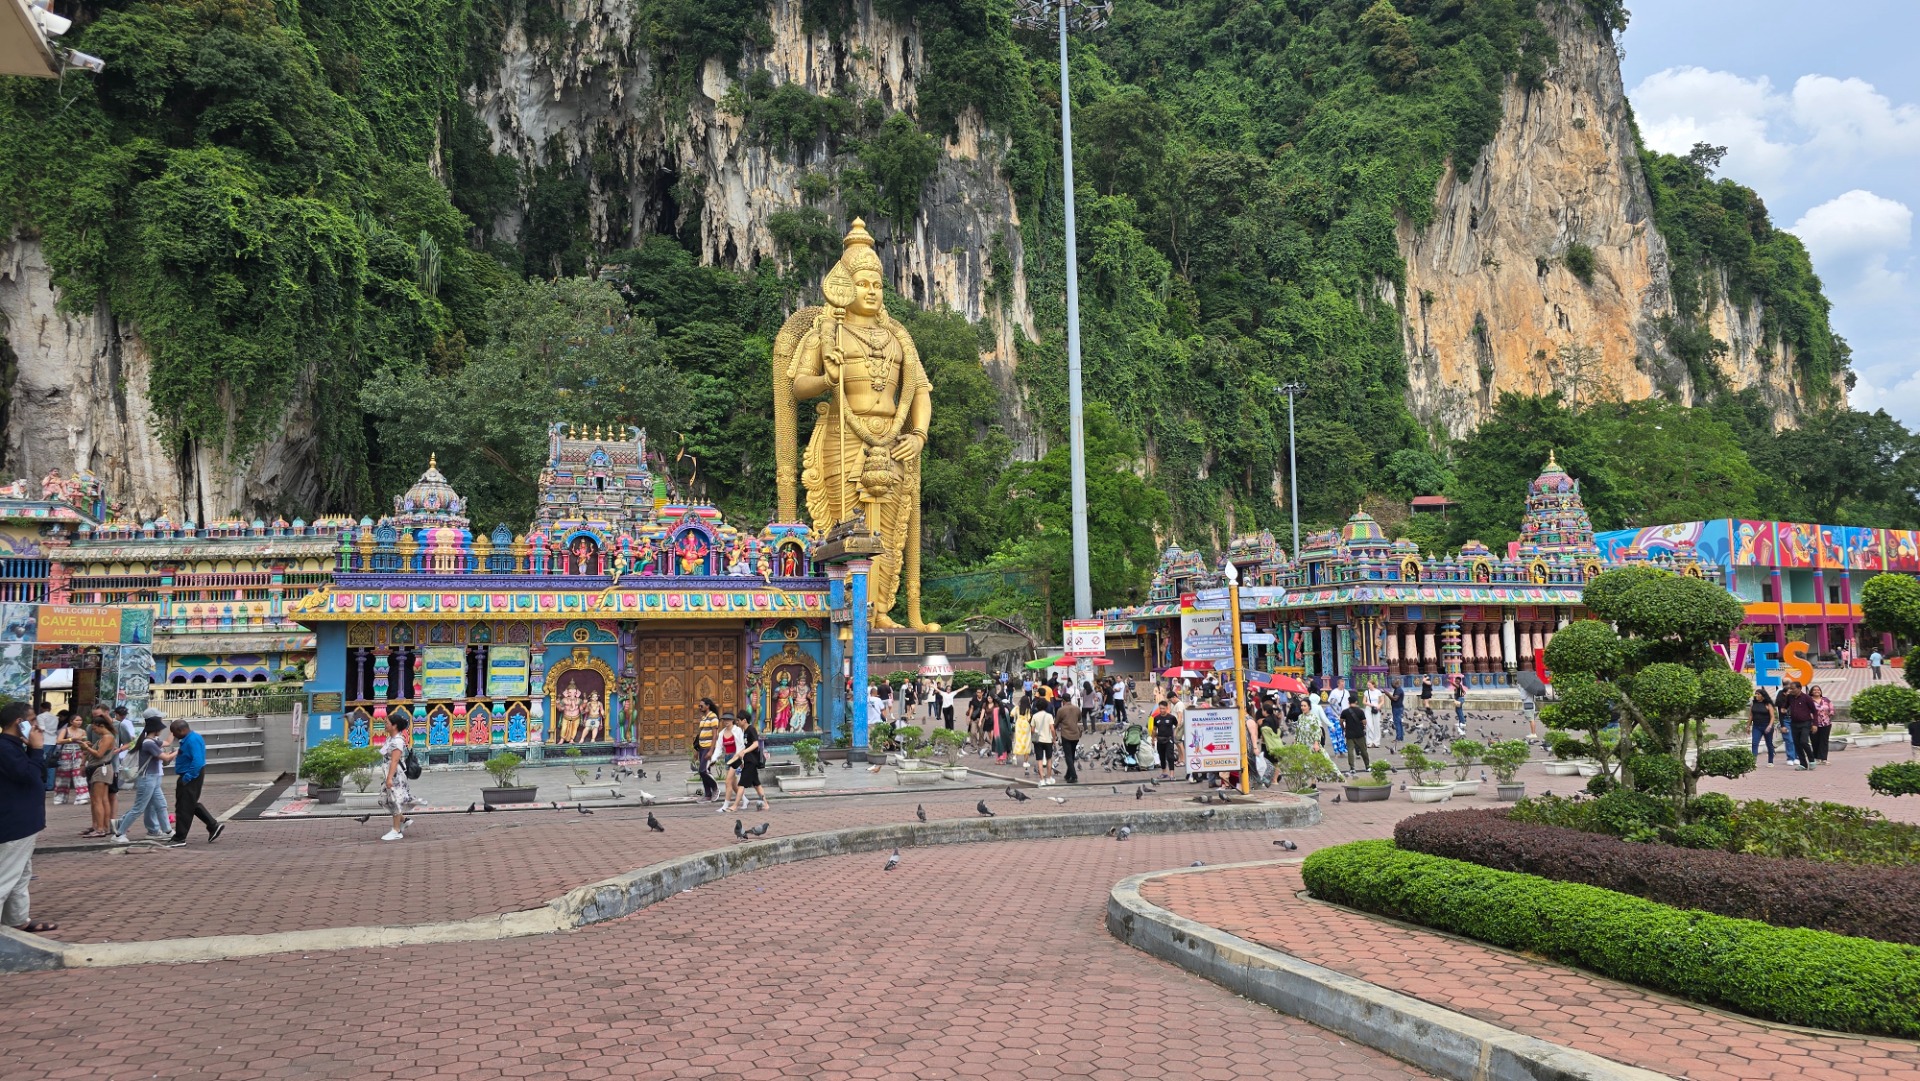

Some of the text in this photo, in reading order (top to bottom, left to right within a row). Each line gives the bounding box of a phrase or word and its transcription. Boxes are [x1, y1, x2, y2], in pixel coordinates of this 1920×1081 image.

[53, 607, 94, 615] WELCOME
[40, 616, 118, 628] CAVE VILLA
[53, 628, 106, 637] ART GALLERY
[1713, 641, 1814, 686] VES
